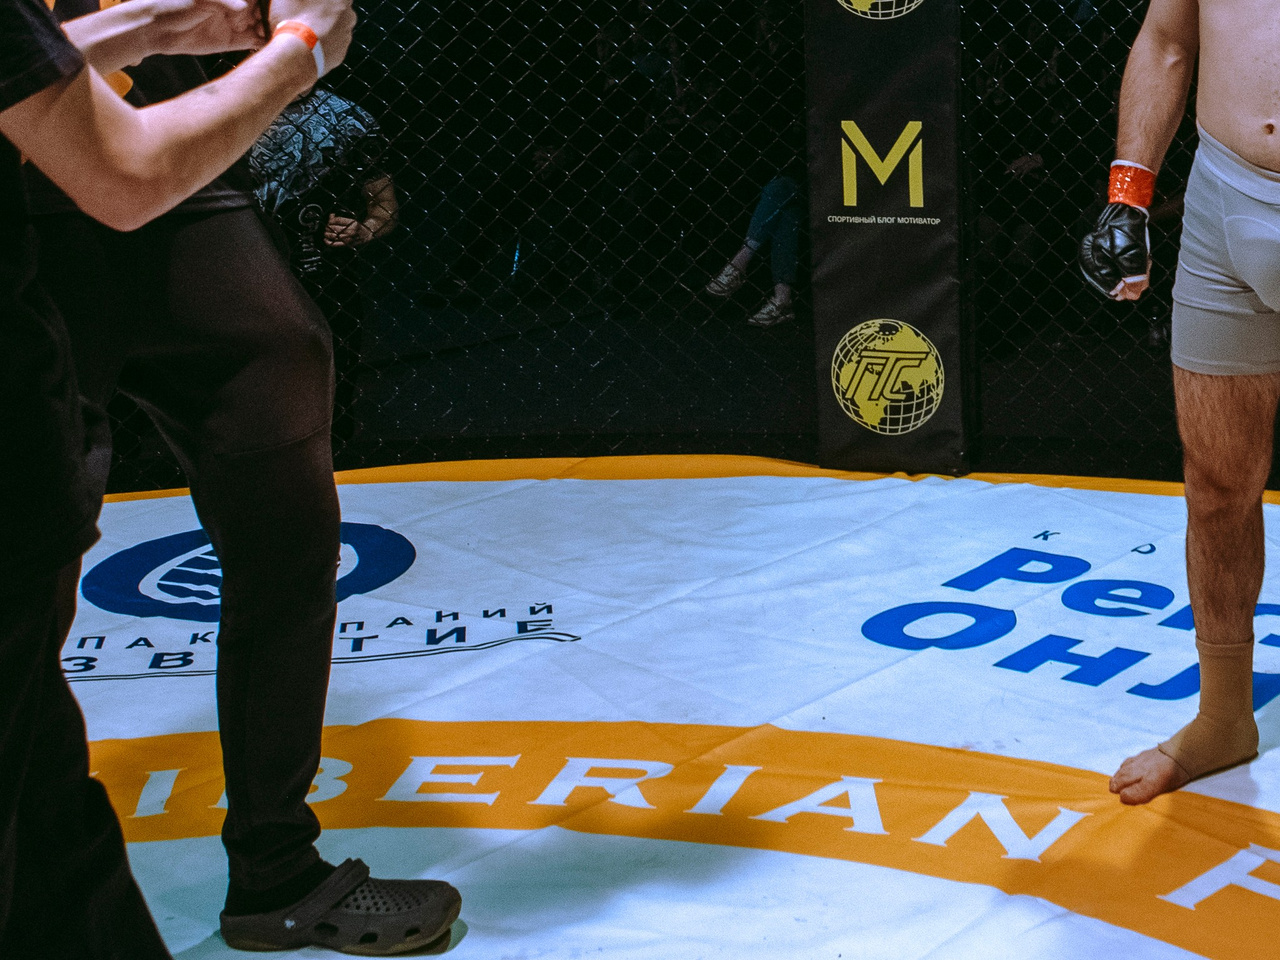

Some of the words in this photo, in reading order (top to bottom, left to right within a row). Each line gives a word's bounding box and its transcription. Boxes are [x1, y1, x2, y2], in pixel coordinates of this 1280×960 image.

[827, 215, 876, 224] СПОРТИВНЫЙ
[877, 216, 895, 224] БЛОГ
[897, 217, 941, 225] МОТИВАТОР
[90, 753, 1094, 863] IBERIAN
